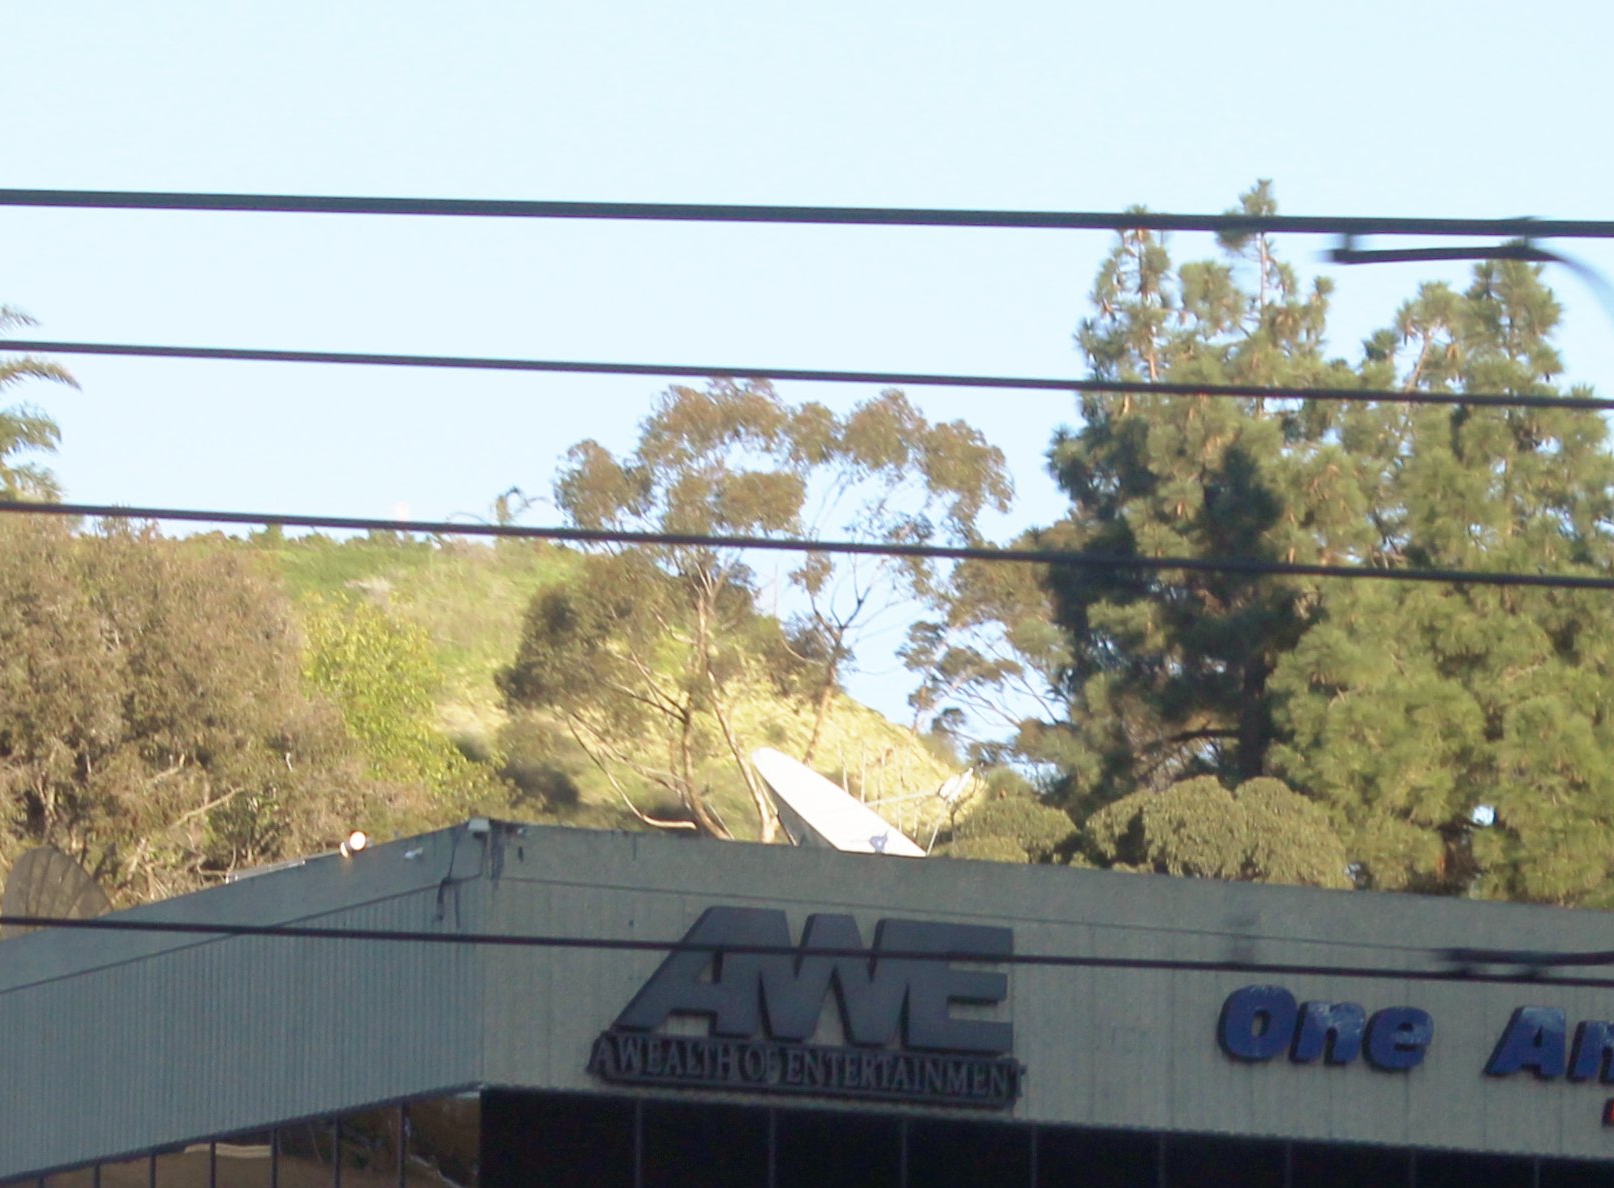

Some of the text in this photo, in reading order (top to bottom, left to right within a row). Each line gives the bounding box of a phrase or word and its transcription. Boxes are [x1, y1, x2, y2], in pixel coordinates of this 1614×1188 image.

[613, 905, 1015, 1054] AWE
[592, 1034, 1027, 1099] A WEALTH OF ENTERTAINMENT
[1216, 985, 1435, 1069] One
